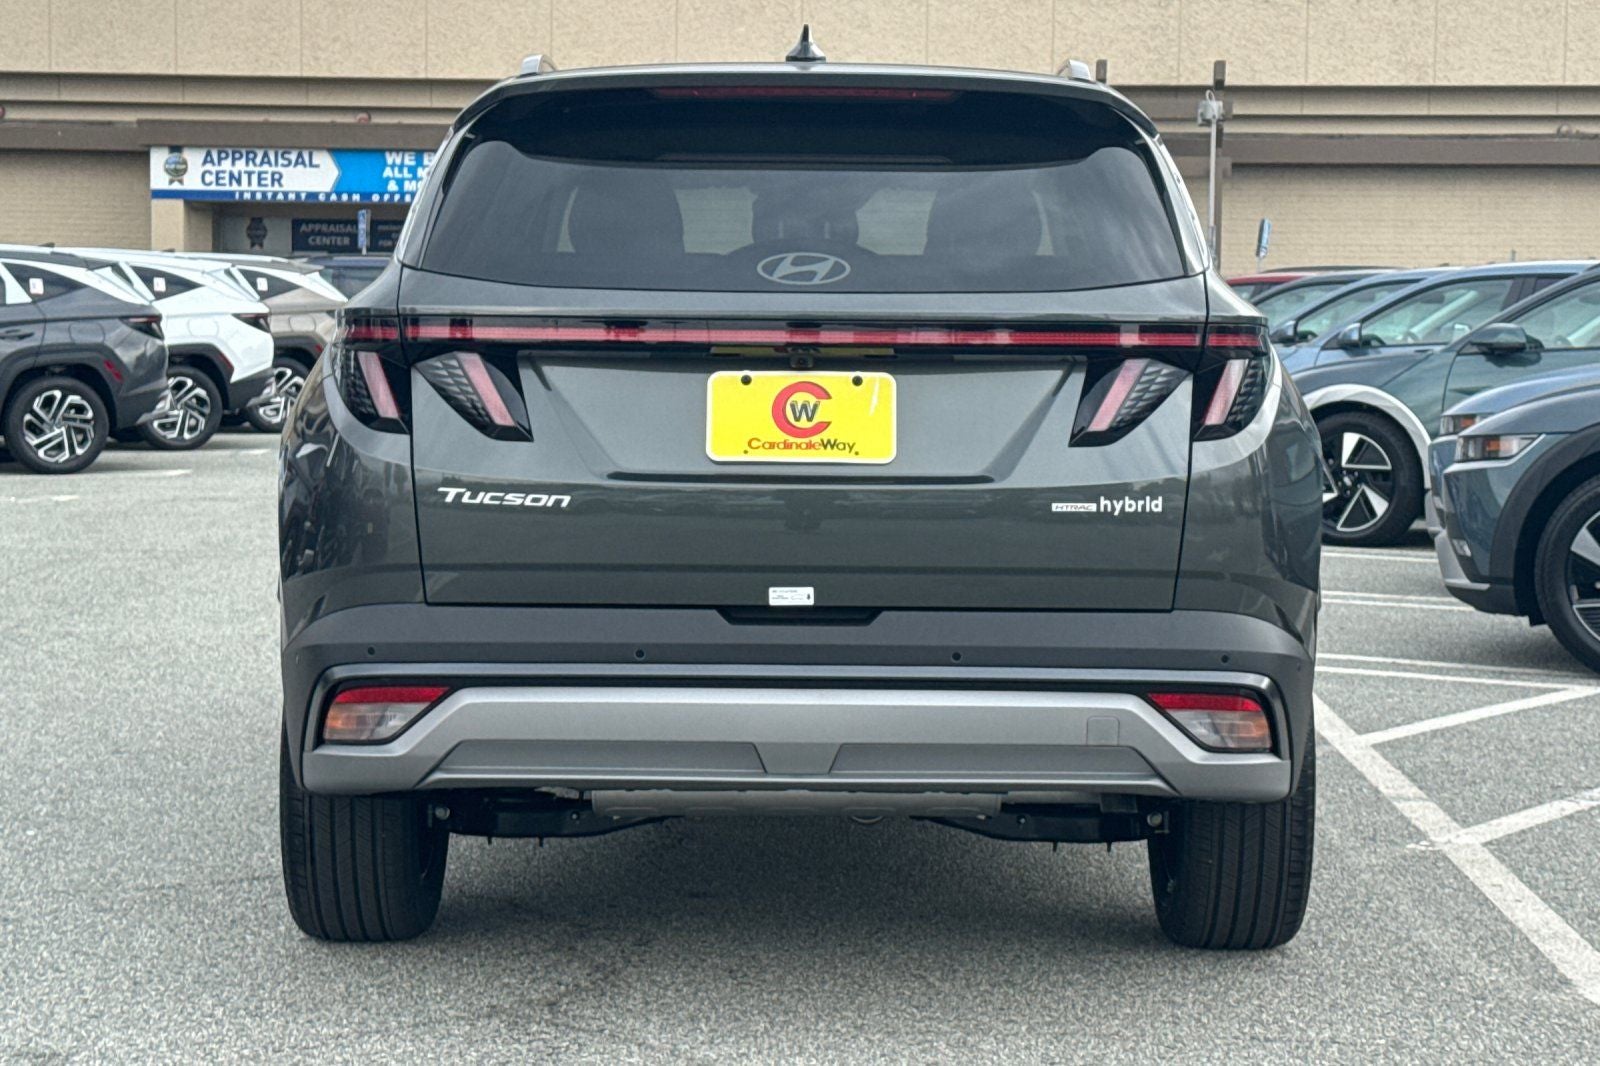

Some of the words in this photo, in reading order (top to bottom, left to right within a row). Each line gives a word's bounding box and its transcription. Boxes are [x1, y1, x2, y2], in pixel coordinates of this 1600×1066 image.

[201, 150, 321, 168] APPRAISAL
[385, 151, 417, 166] WE
[200, 170, 284, 188] CENTER
[382, 166, 413, 178] ALL
[387, 179, 399, 192] &
[234, 191, 307, 201] INSTANT
[318, 192, 361, 202] CASH
[308, 235, 350, 246] CENTER
[747, 437, 857, 454] CardinaleWay
[1099, 495, 1163, 516] hybrid
